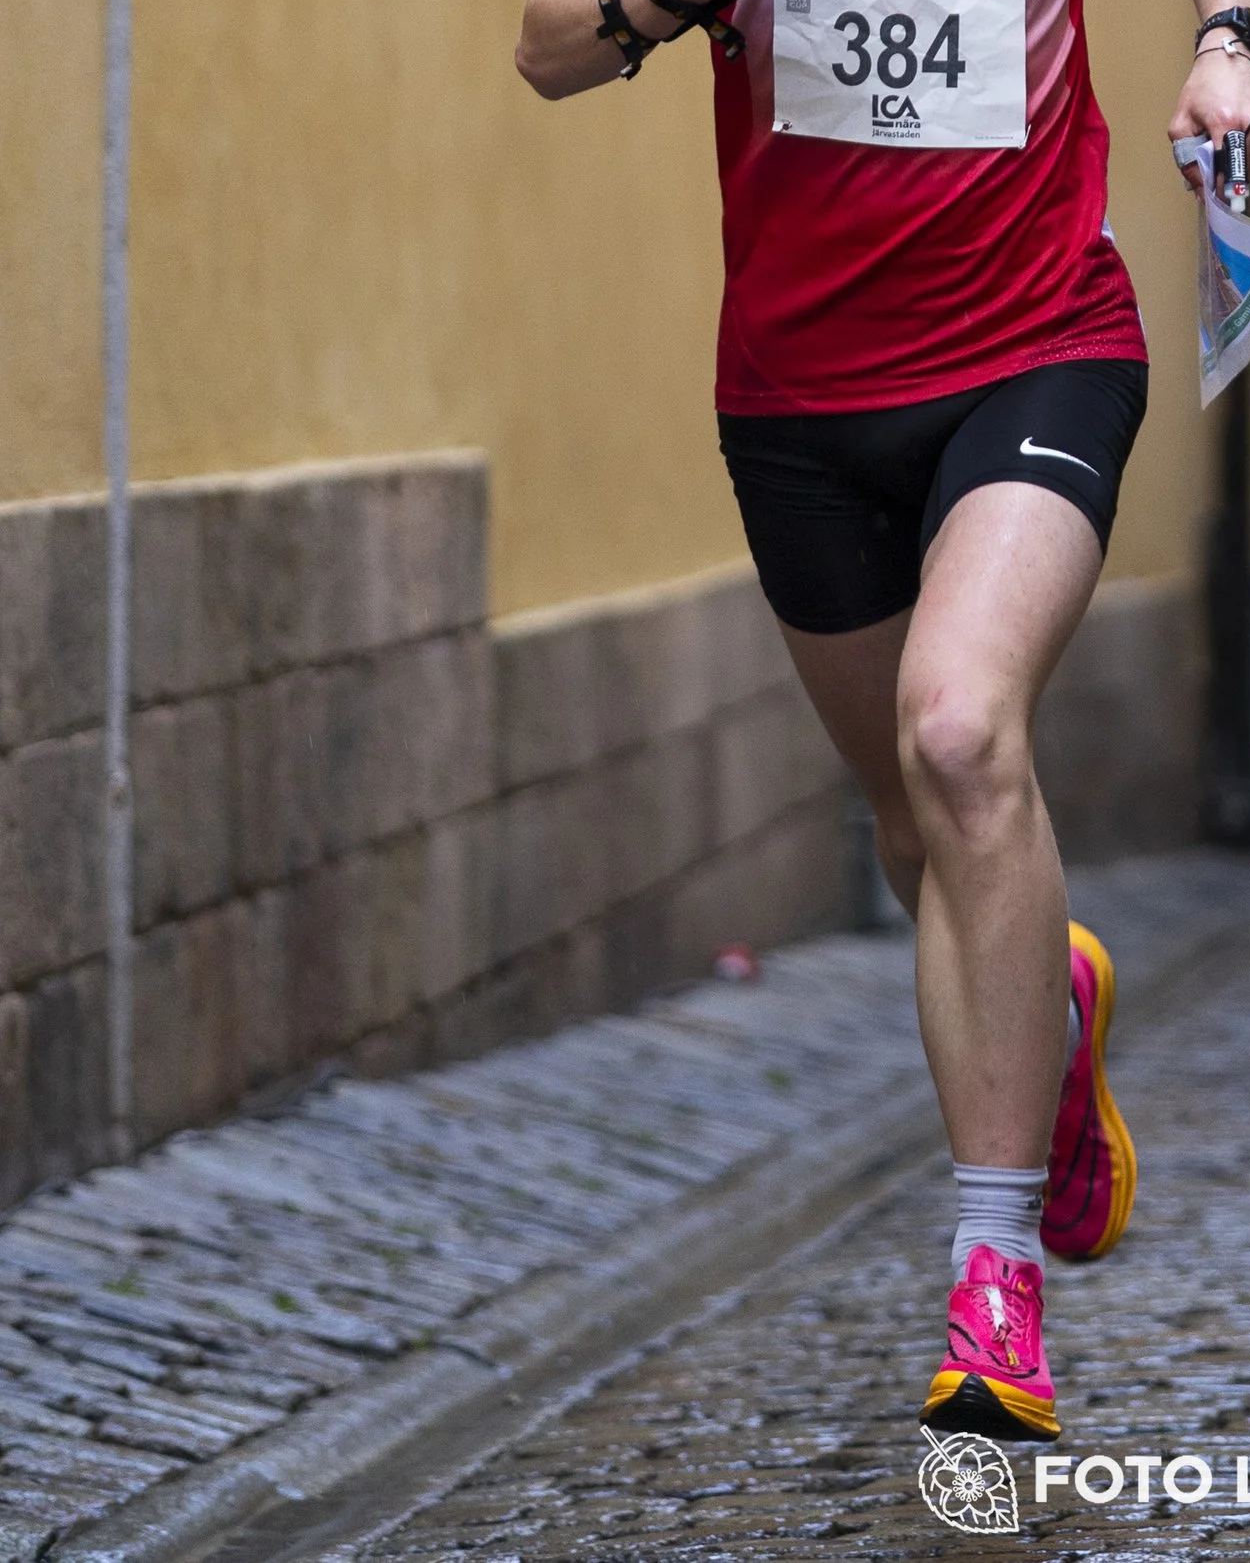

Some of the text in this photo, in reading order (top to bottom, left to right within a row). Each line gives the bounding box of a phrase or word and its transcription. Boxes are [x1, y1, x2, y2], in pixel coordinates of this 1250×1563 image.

[832, 10, 966, 89] 384
[872, 94, 921, 119] ICA
[895, 119, 921, 129] nära
